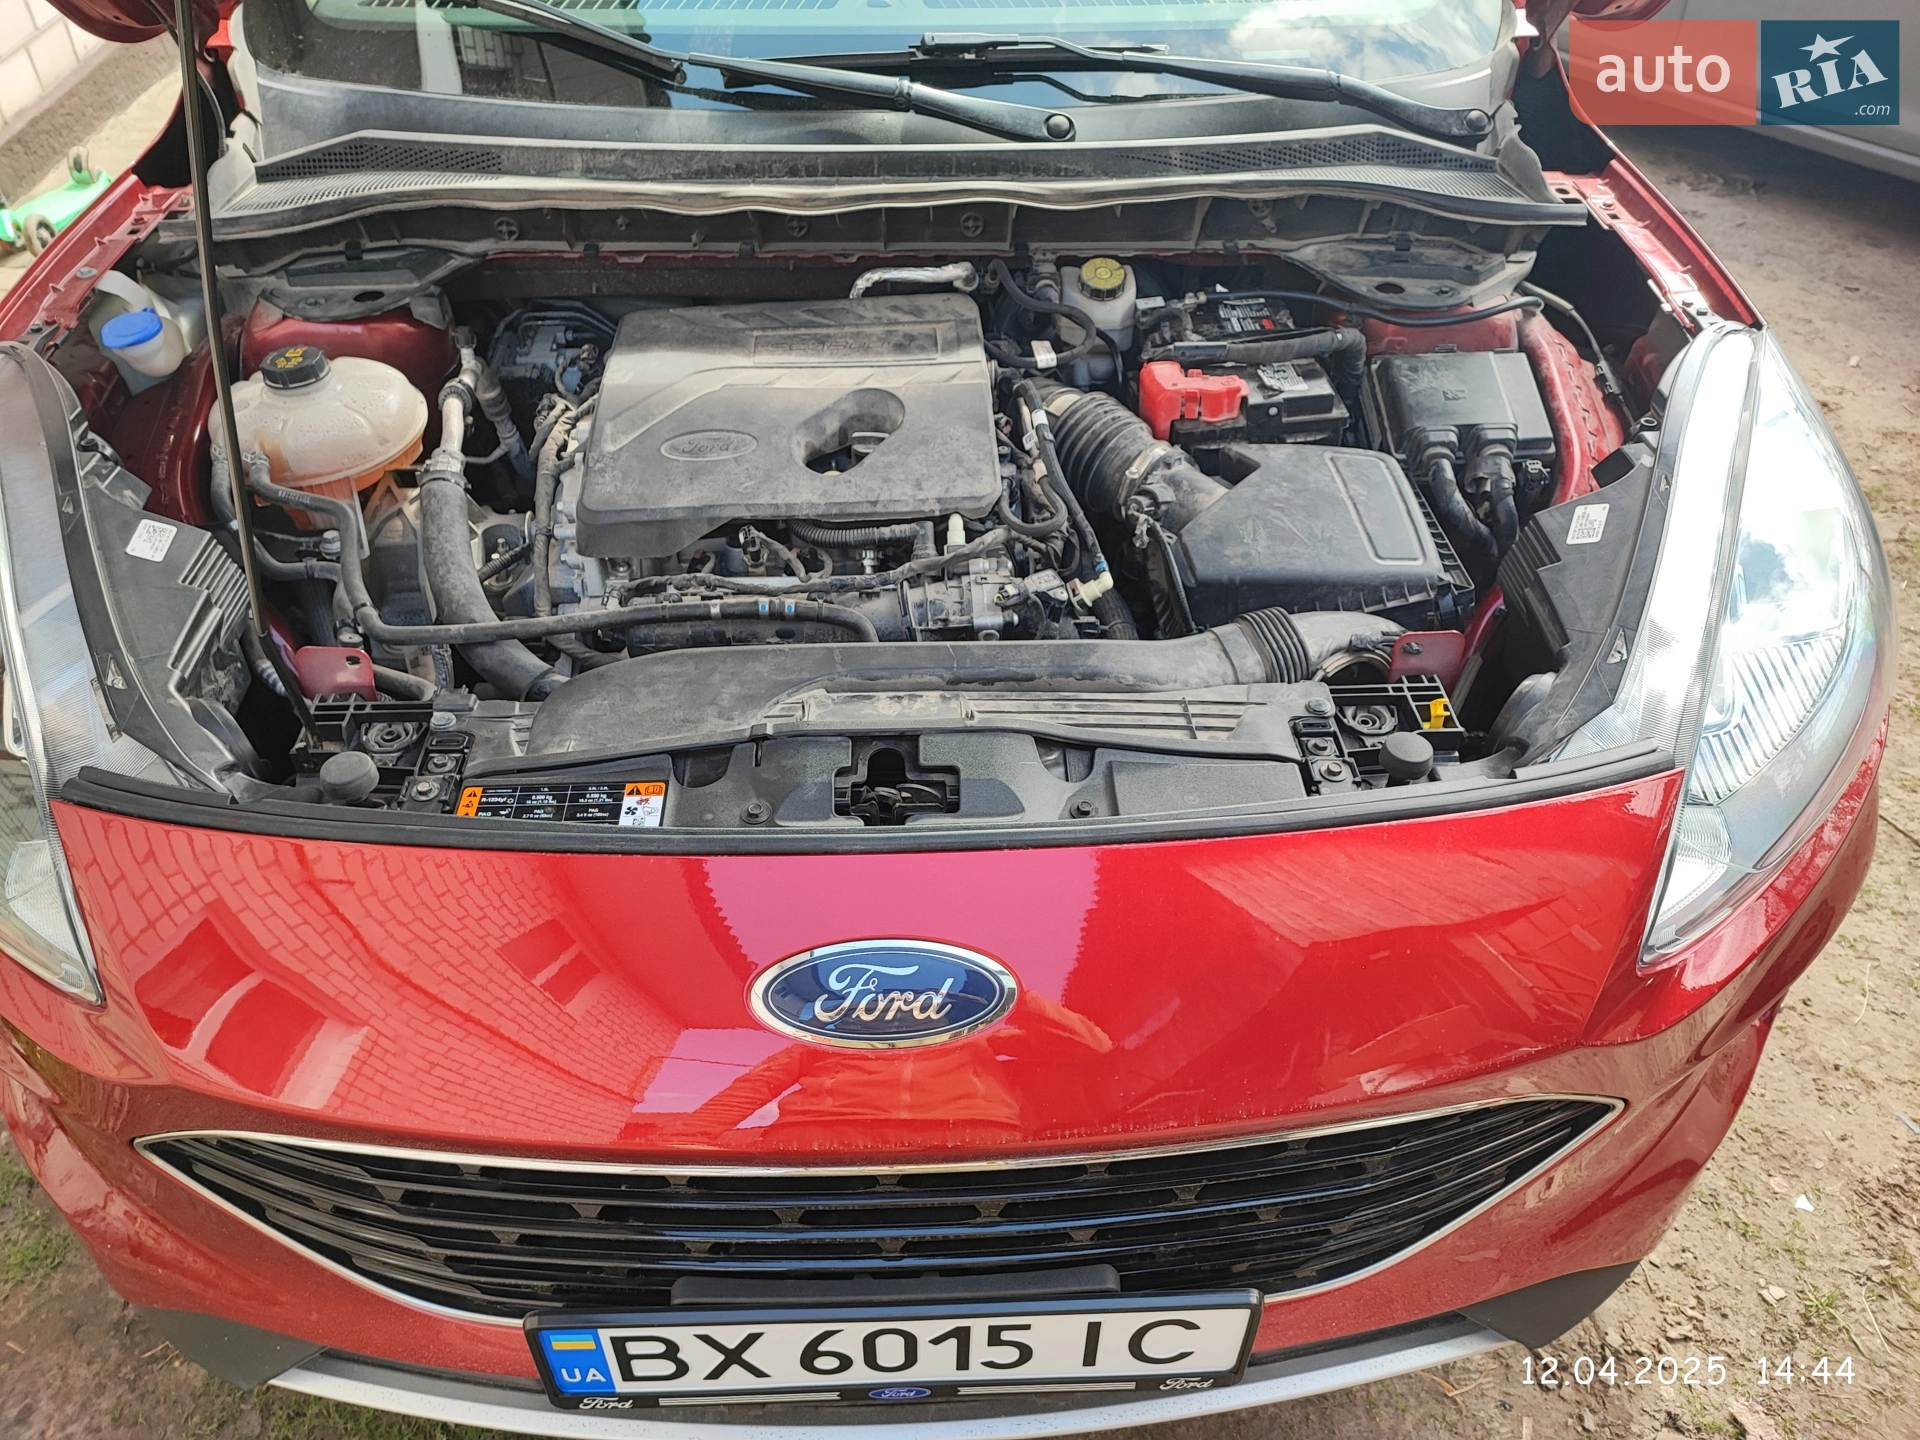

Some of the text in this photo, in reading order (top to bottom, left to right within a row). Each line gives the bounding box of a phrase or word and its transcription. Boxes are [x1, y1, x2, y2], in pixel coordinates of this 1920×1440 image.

[682, 437, 735, 454] Ford
[813, 963, 955, 1023] Ford
[609, 1318, 1201, 1382] BX 6015 IC
[561, 1367, 607, 1383] UA
[1159, 1376, 1215, 1391] Ford
[881, 1388, 917, 1397] Ford
[579, 1396, 634, 1410] Ford
